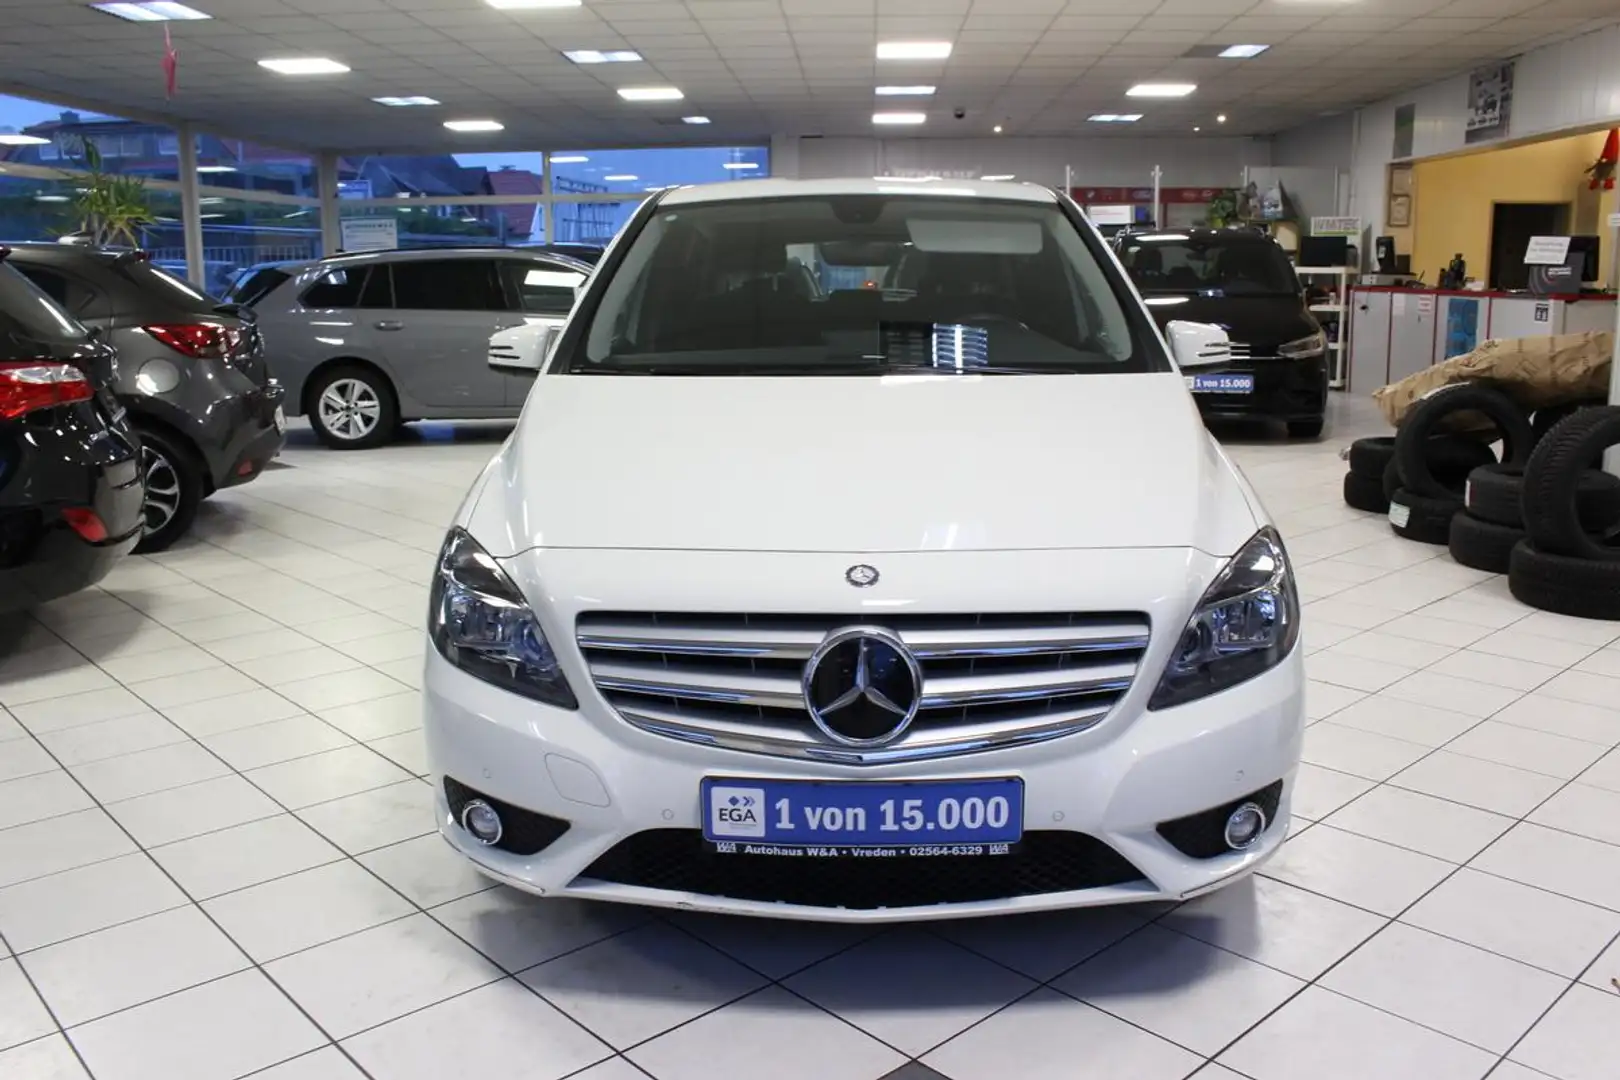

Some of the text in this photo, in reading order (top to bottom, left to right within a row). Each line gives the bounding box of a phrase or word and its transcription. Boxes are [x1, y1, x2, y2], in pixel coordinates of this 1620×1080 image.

[1195, 379, 1251, 388] 1 von 15.000
[719, 808, 757, 822] EGA
[775, 796, 1009, 831] 1 von 15.000
[744, 845, 803, 856] Autohaus
[807, 847, 838, 857] W&A
[852, 847, 896, 857] Vreden
[909, 845, 983, 857] 02564-6329
